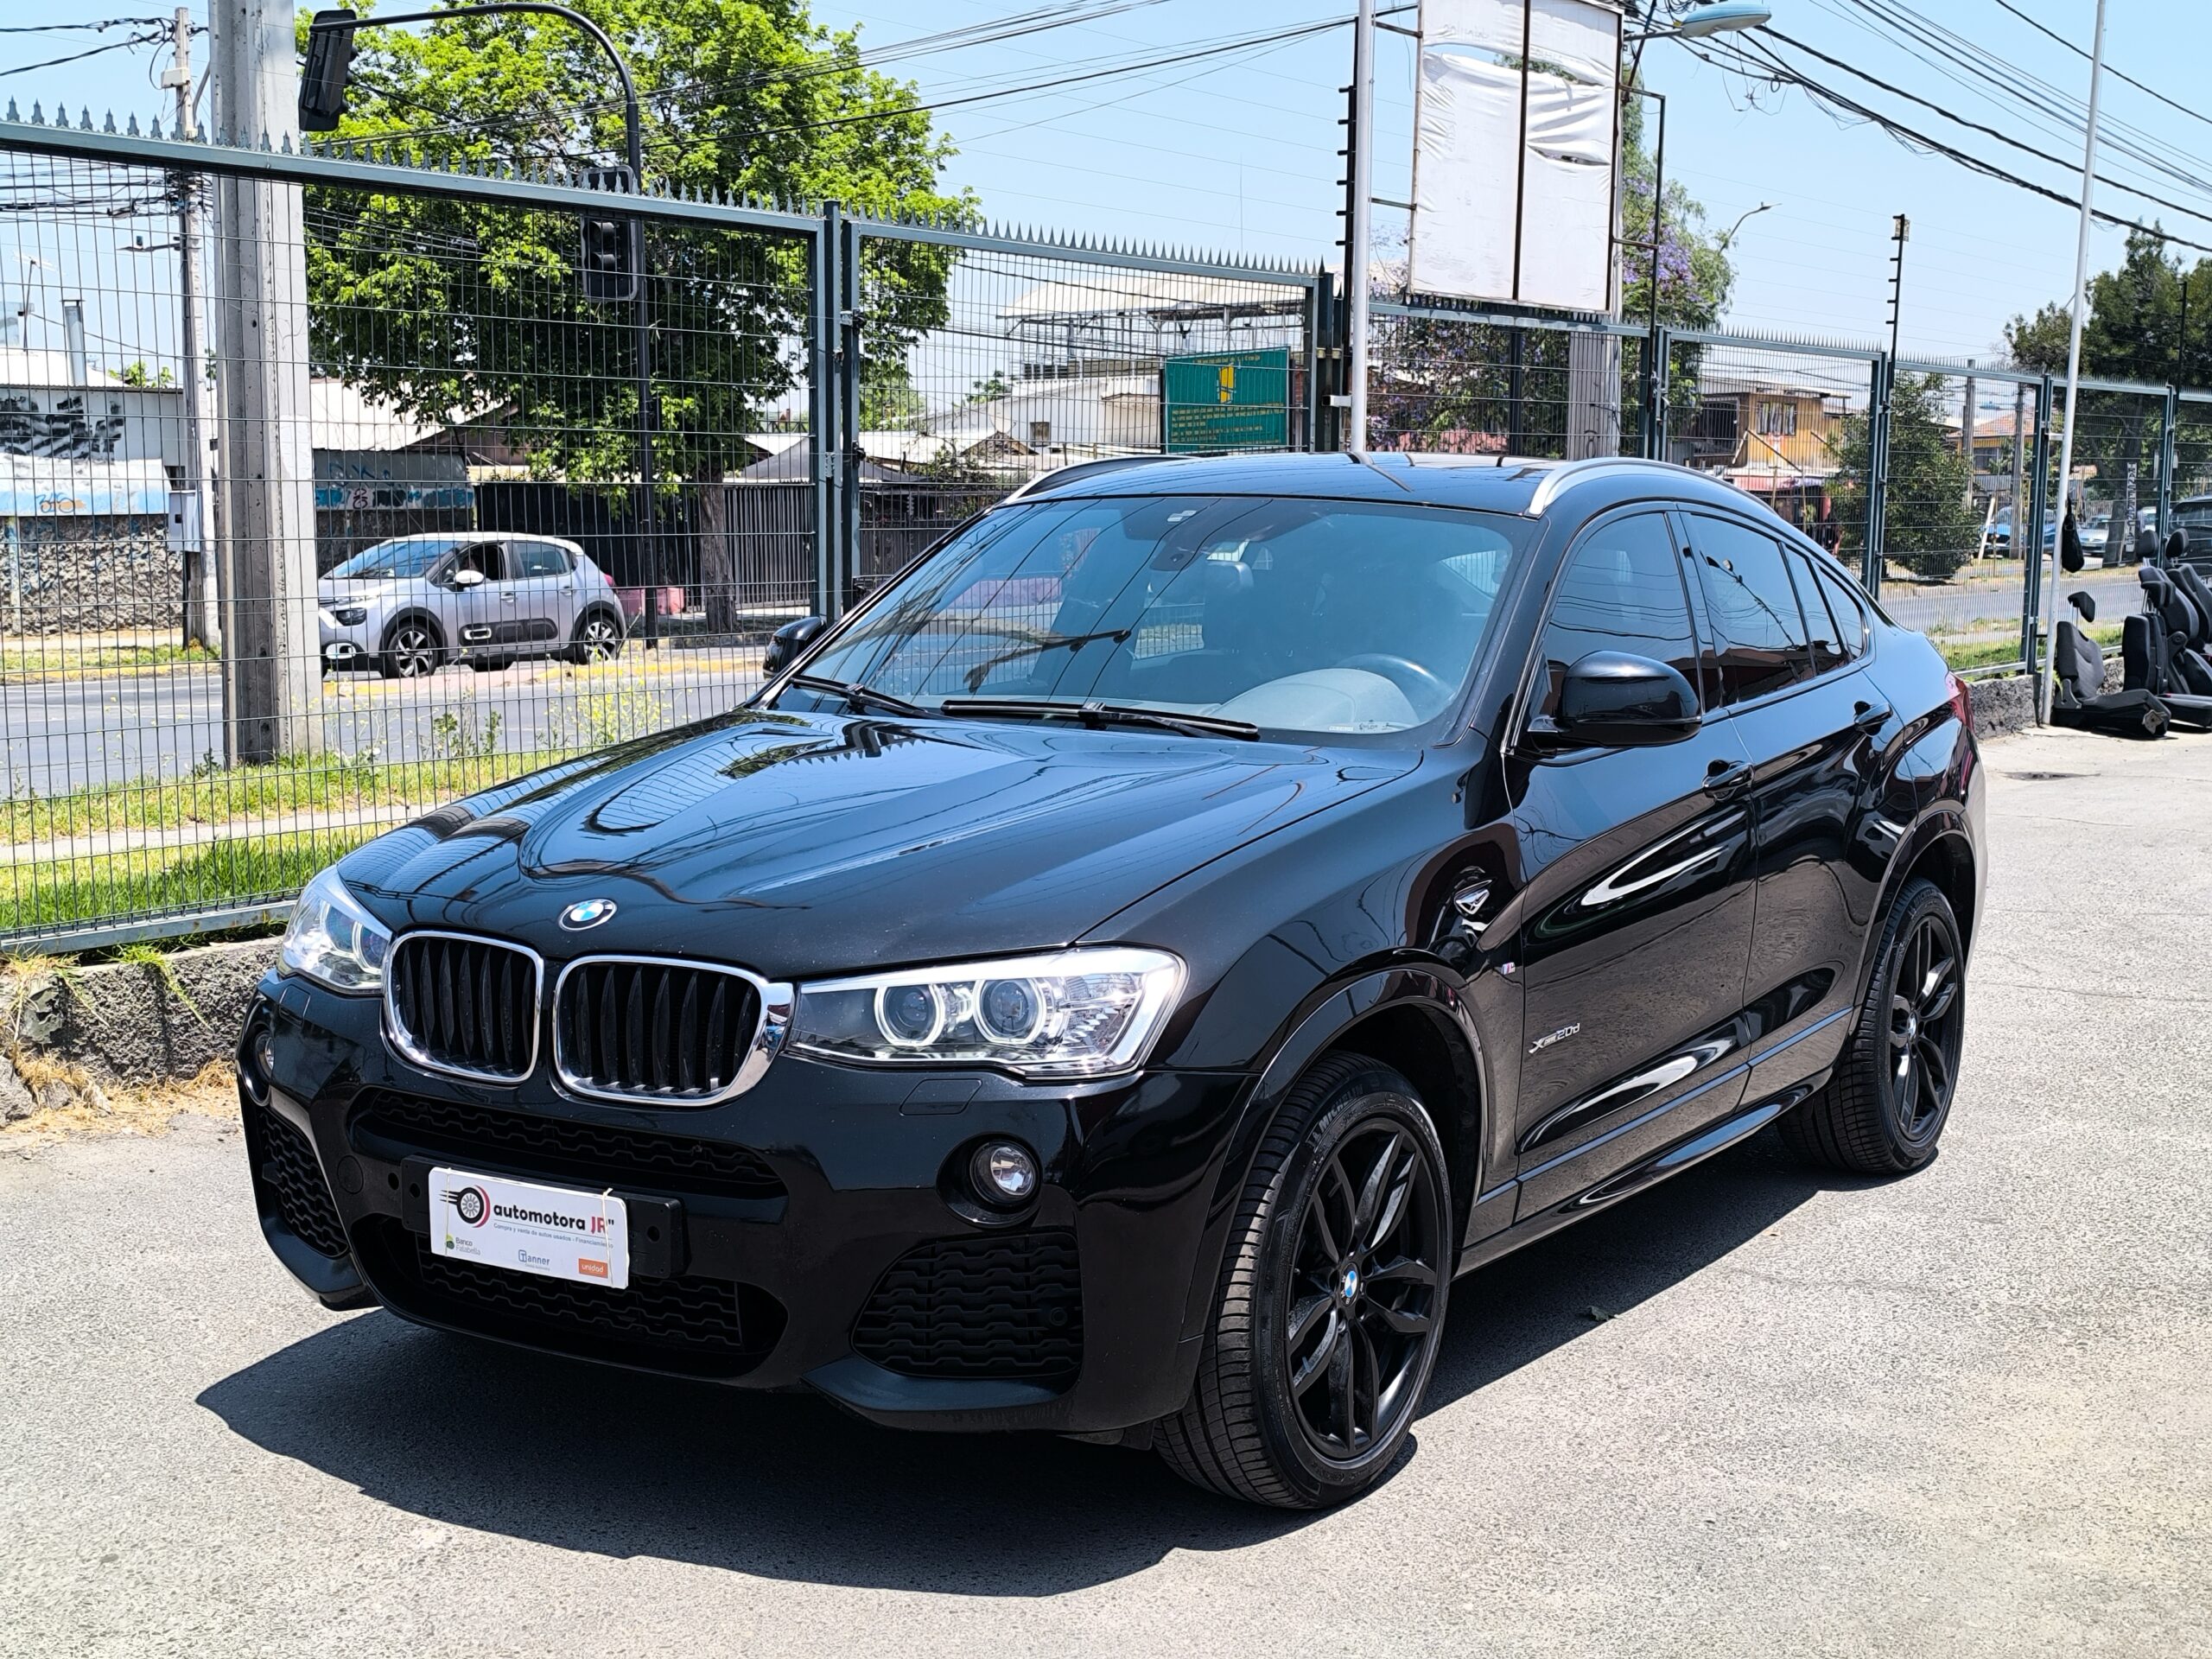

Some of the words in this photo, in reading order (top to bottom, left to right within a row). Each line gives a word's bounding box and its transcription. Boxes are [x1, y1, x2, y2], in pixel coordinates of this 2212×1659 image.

[1319, 1083, 1363, 1133] MICHELIN
[493, 1205, 586, 1230] automotora
[455, 1236, 473, 1247] Banco
[582, 1263, 604, 1273] unidad
